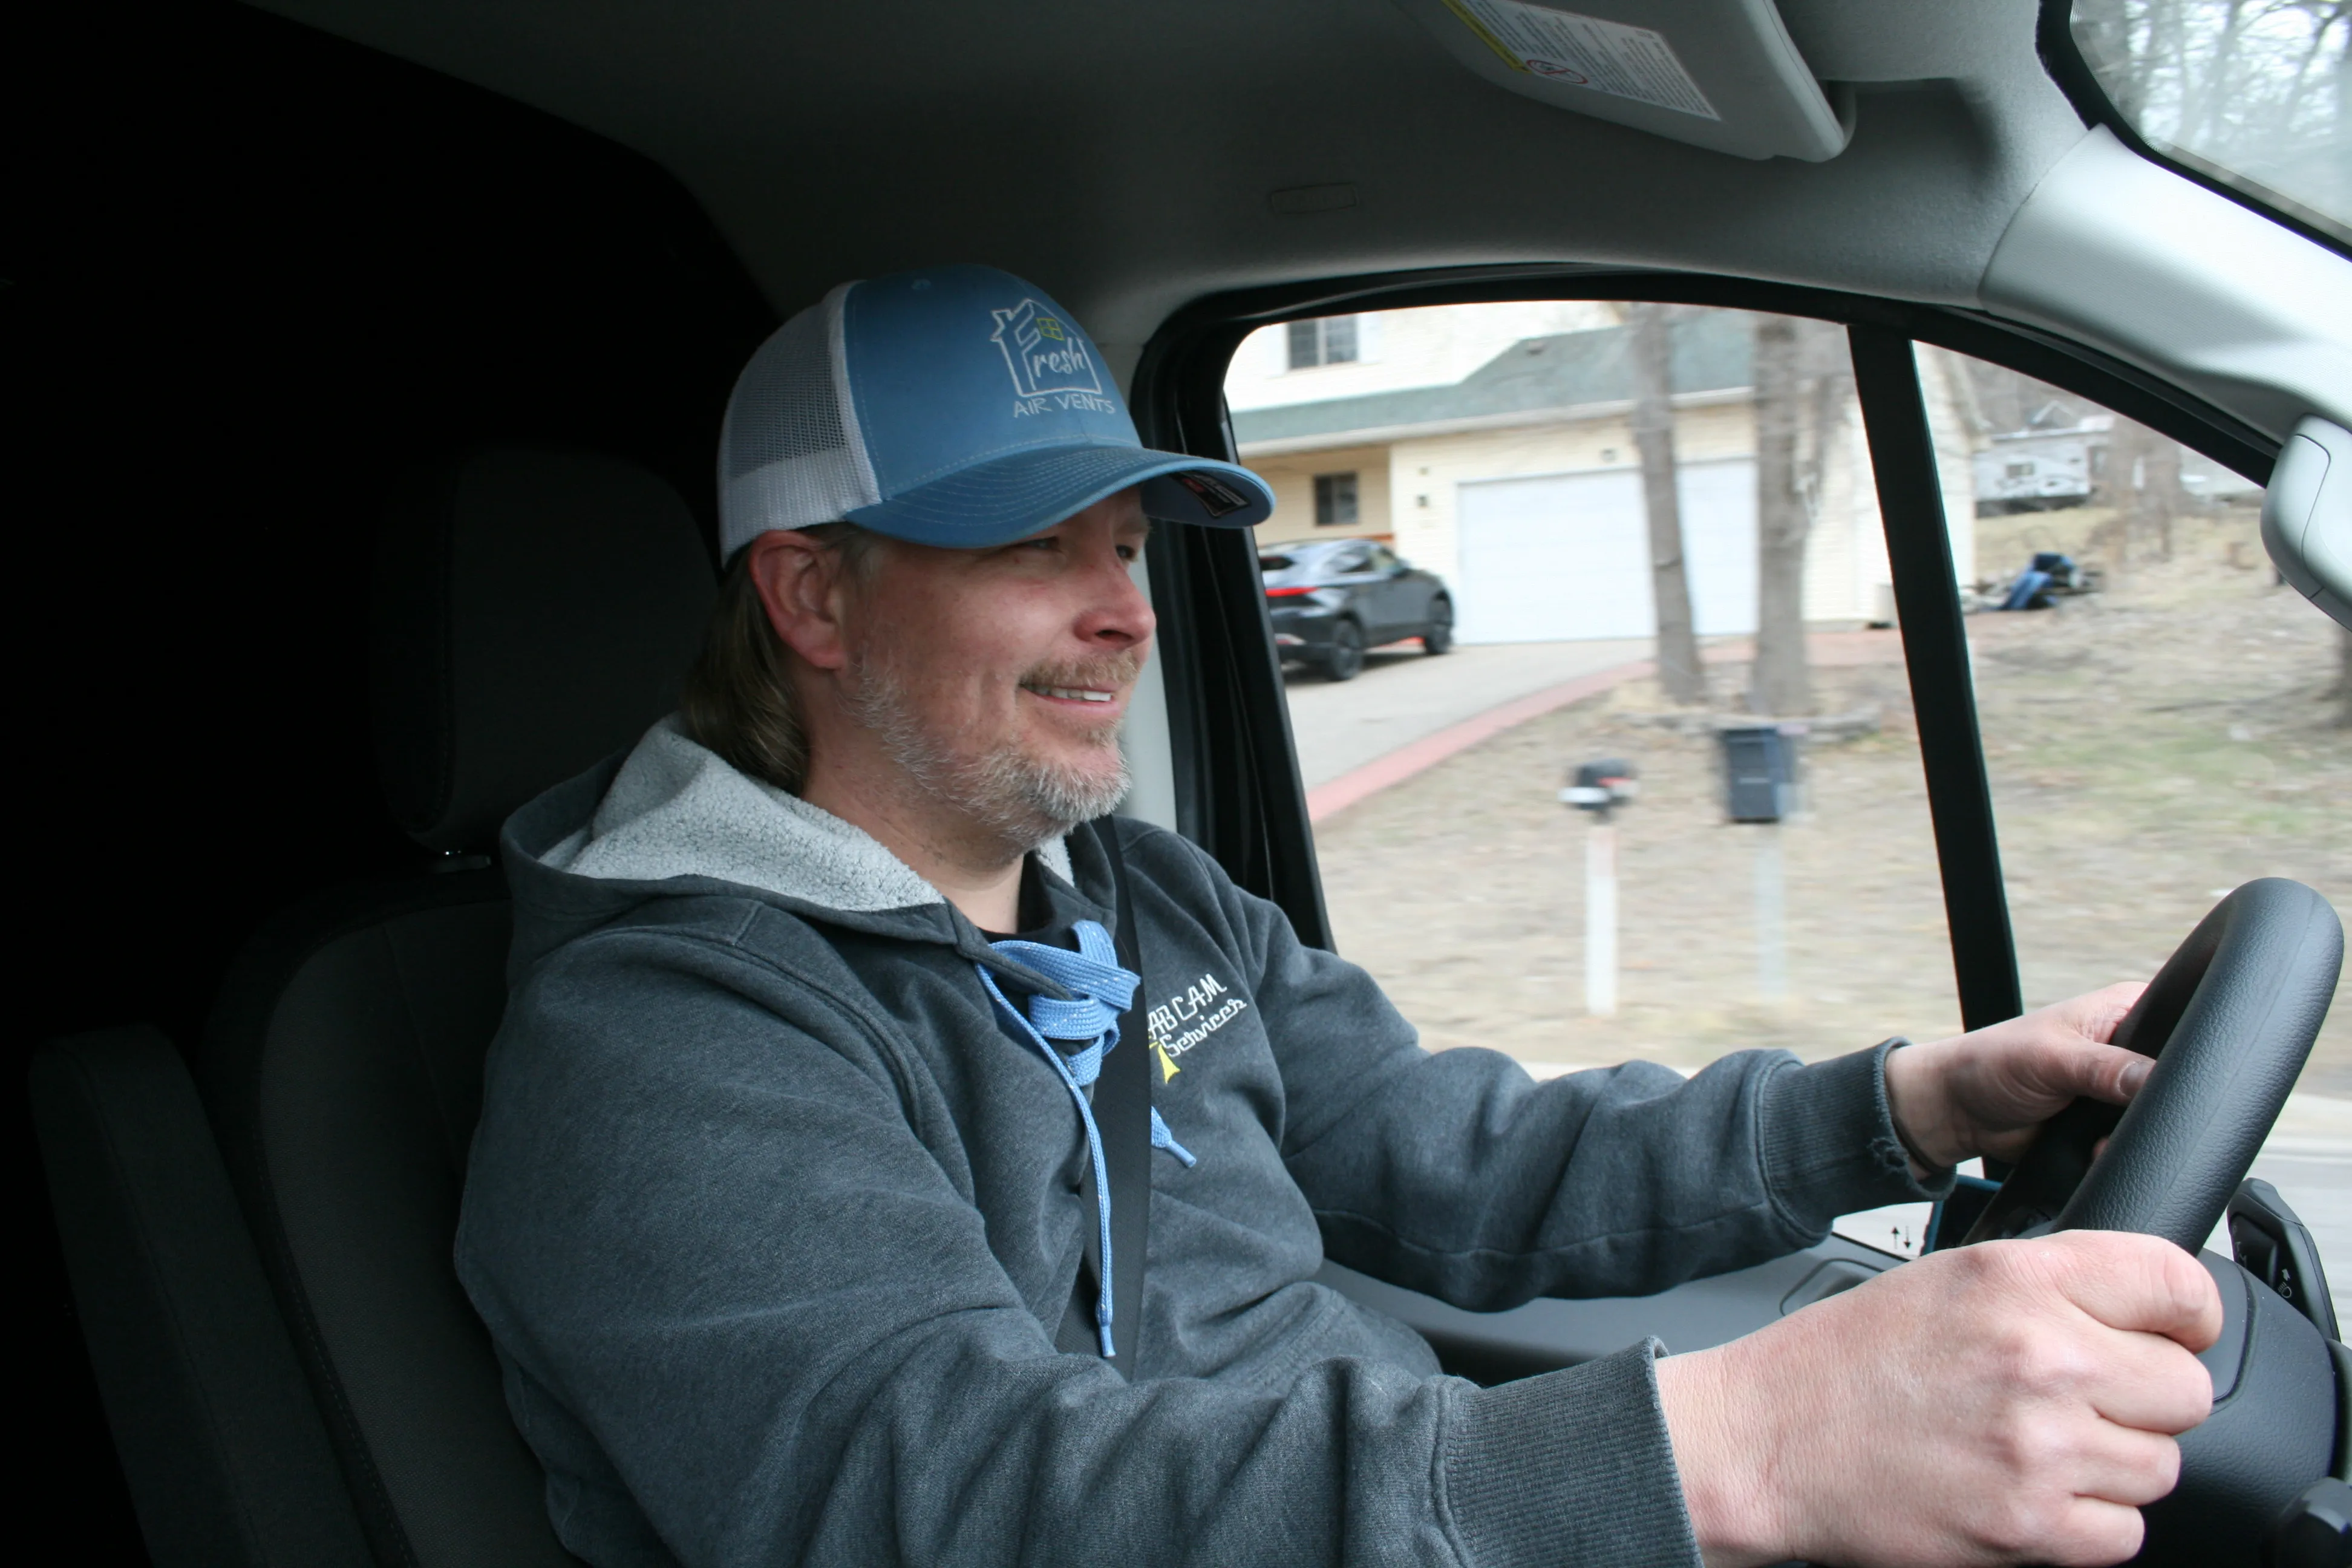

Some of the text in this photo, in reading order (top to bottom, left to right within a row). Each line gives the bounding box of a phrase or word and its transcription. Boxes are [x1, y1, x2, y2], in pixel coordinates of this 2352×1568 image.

[1013, 393, 1116, 418] AIR VENTS
[1158, 998, 1248, 1058] Services
